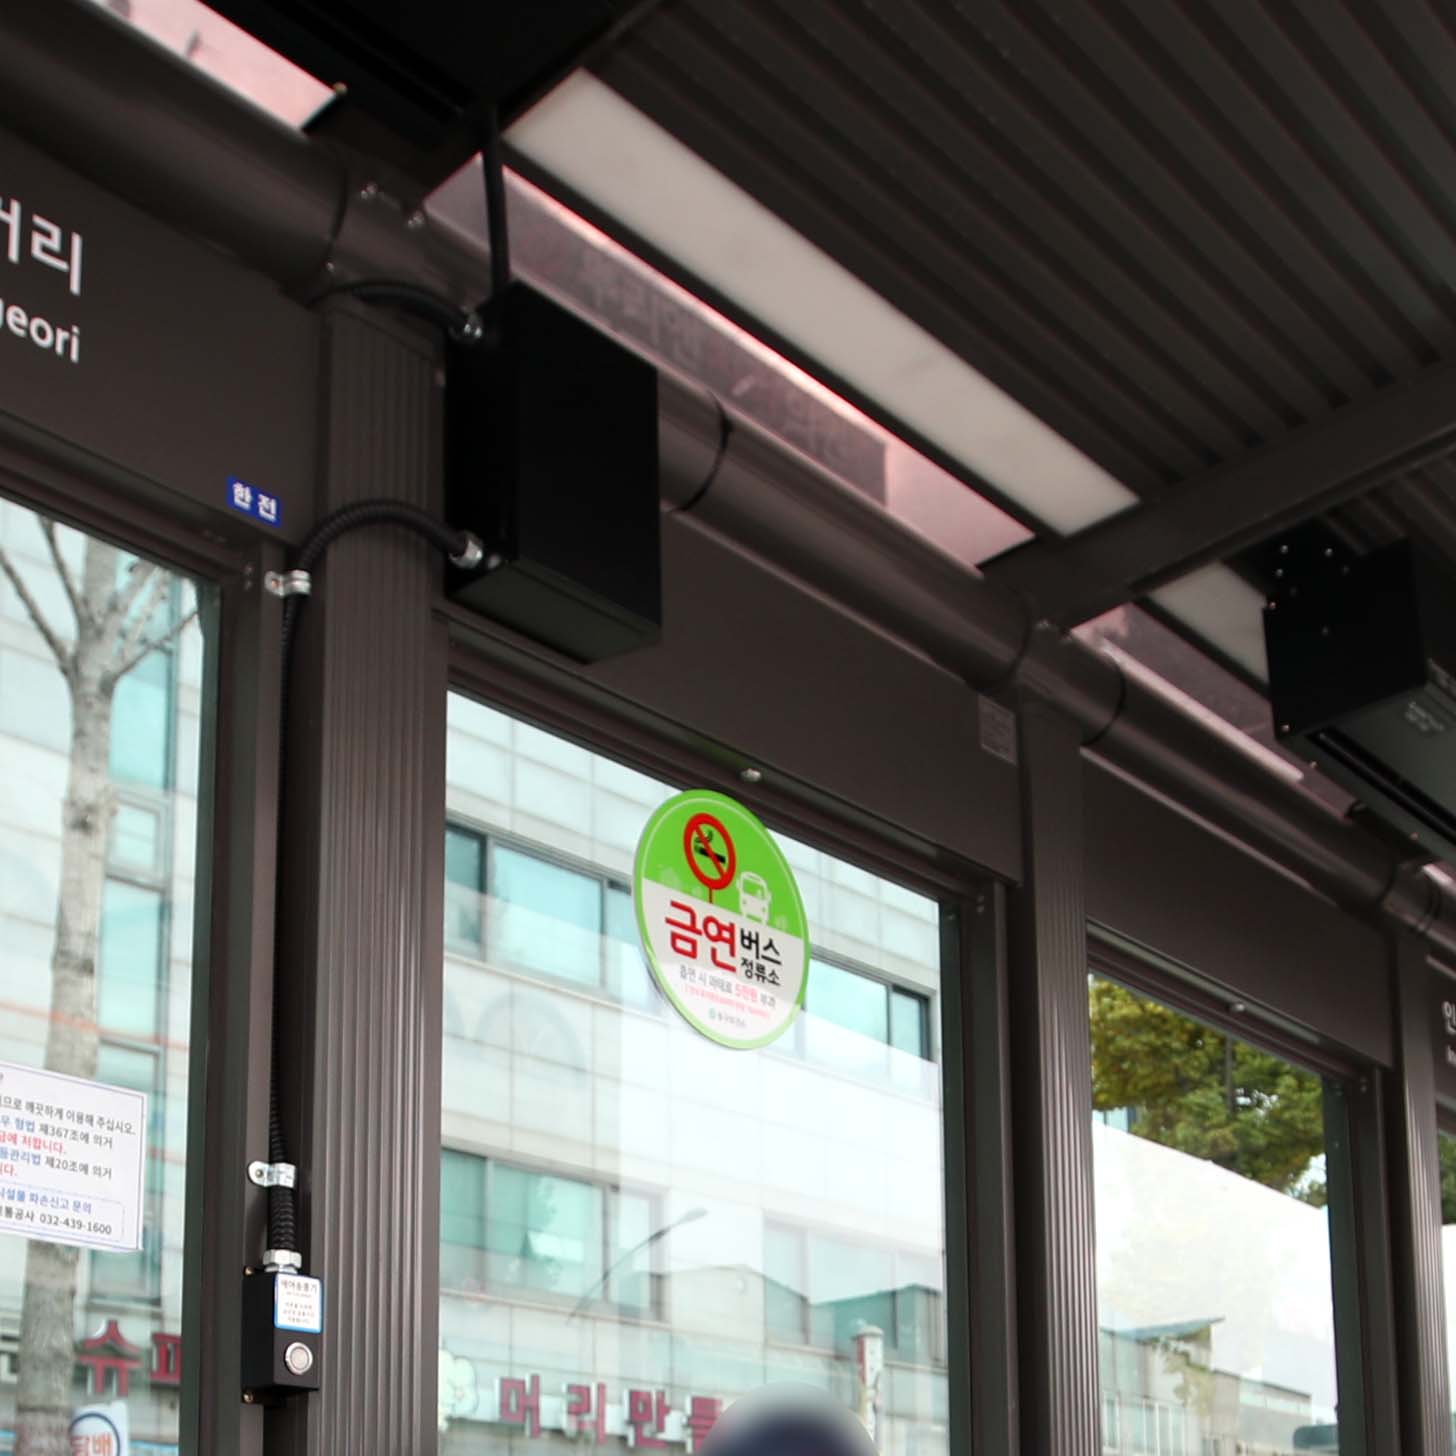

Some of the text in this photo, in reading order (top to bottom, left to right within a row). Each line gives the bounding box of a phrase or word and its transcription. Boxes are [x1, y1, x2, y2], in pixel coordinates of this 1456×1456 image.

[665, 900, 737, 973] 금연
[740, 928, 782, 966] 버스
[740, 957, 781, 986] 정류소
